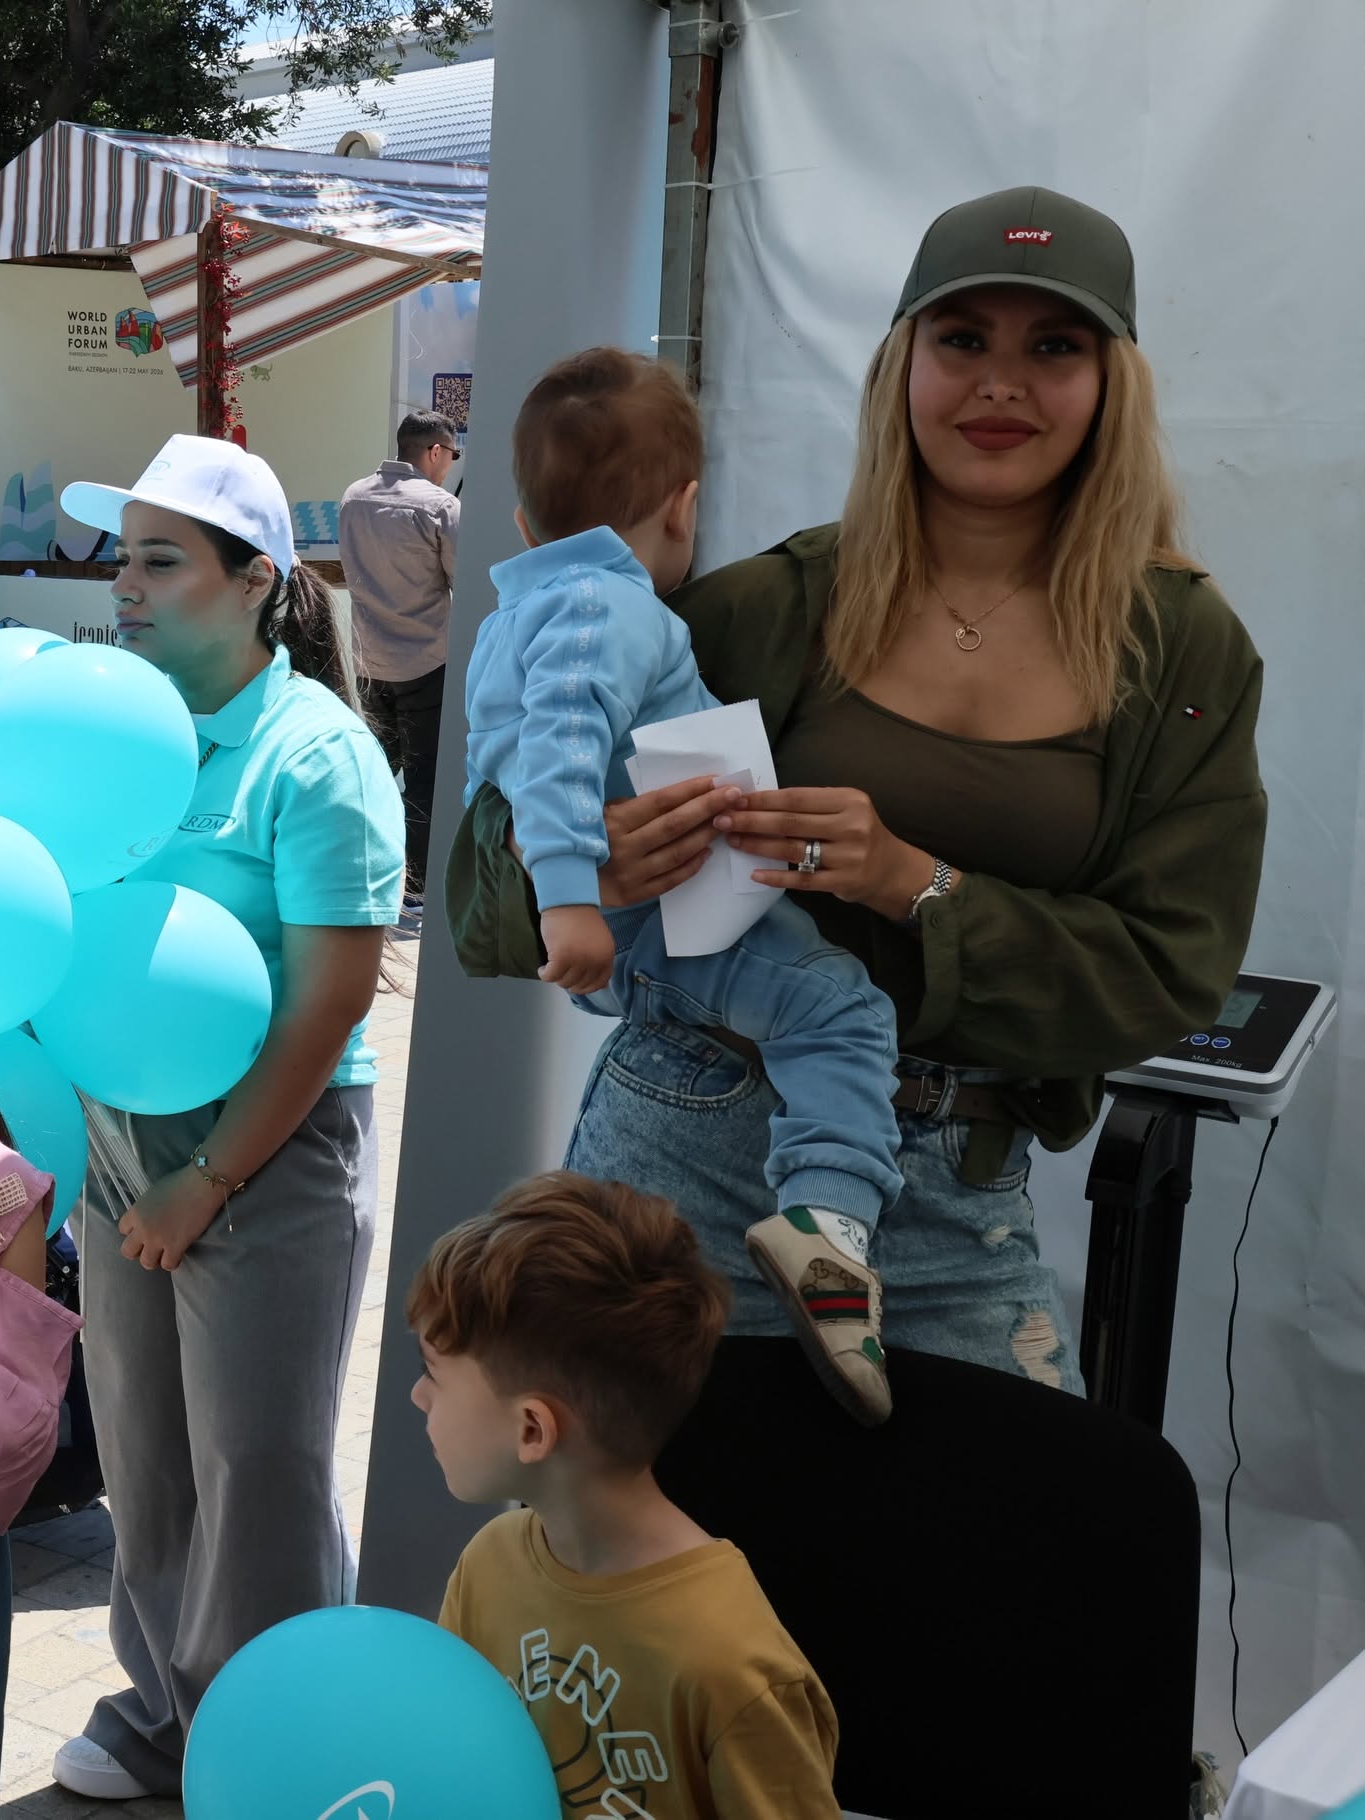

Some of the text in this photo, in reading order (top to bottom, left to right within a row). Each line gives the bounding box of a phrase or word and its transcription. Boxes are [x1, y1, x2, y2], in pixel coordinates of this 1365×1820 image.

[68, 311, 107, 322] WORLD
[68, 325, 107, 336] URBAN
[68, 339, 108, 349] FORUM
[85, 365, 118, 375] AZERBAIJAN
[150, 368, 164, 376] 2026
